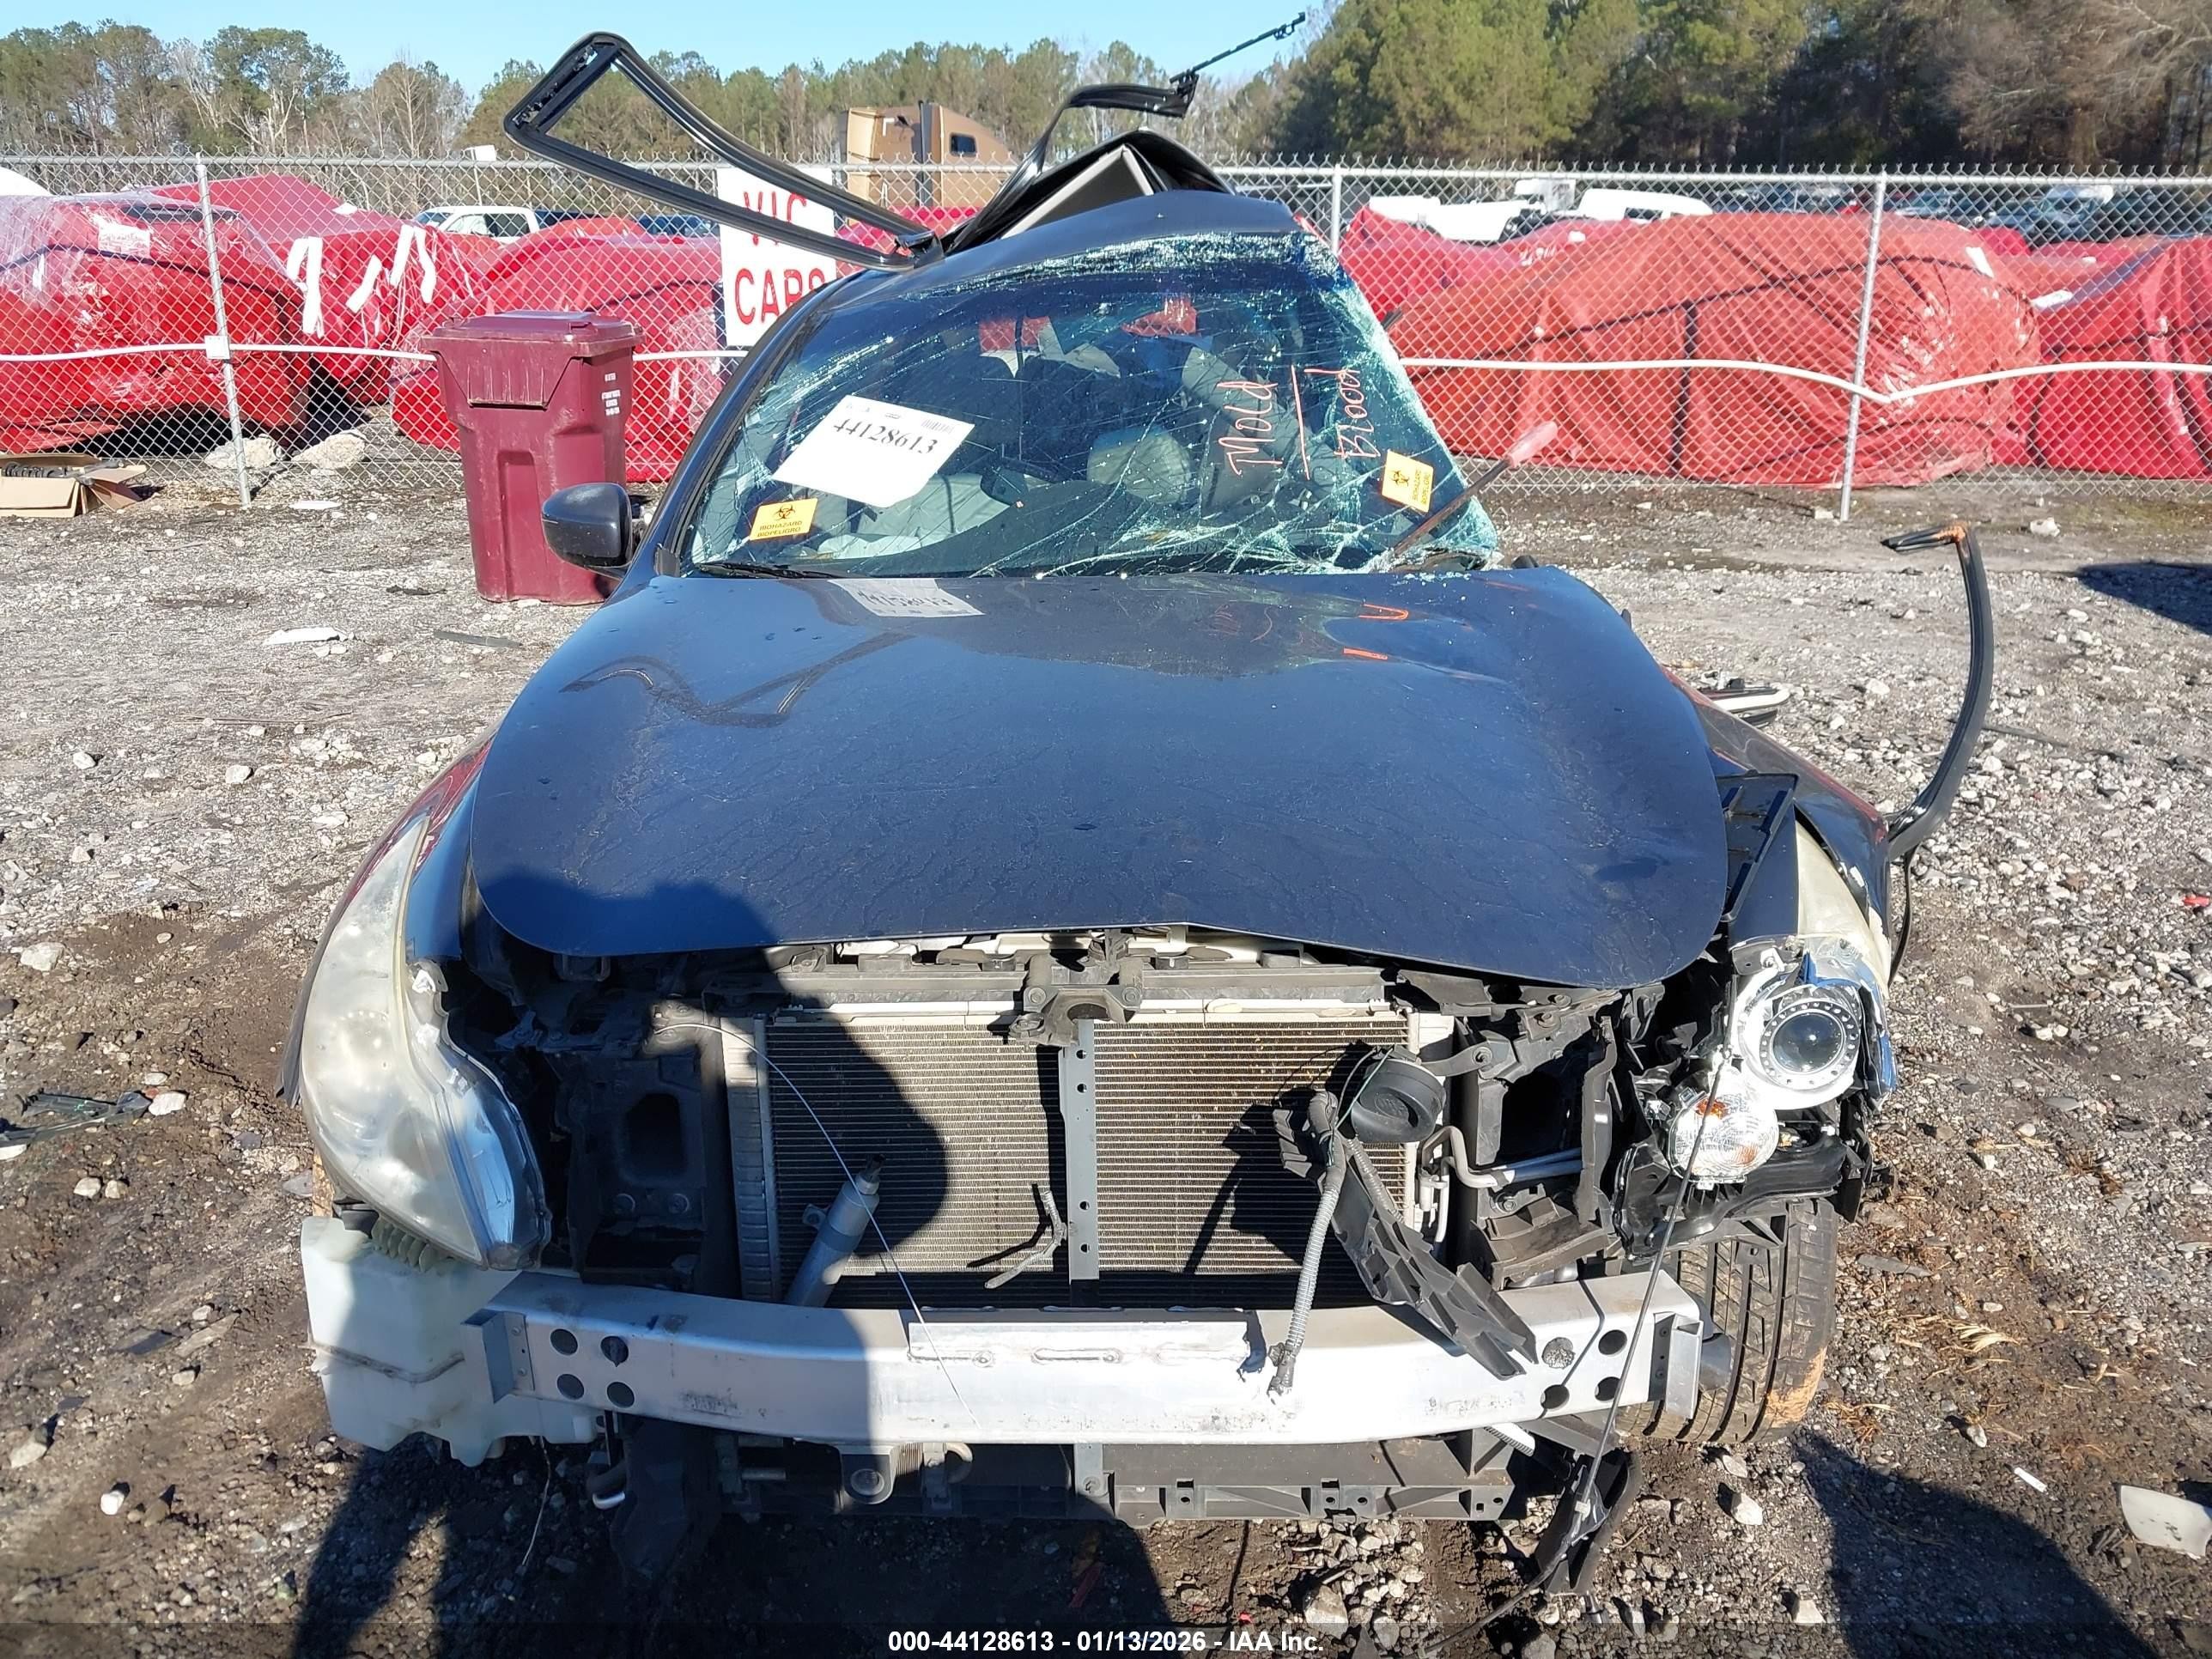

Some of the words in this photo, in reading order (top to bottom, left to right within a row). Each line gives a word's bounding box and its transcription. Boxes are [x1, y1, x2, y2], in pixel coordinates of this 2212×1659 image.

[833, 418, 939, 454] 44128613
[759, 520, 803, 531] BIOHAZARD
[757, 526, 801, 538] BIOPELIGRO
